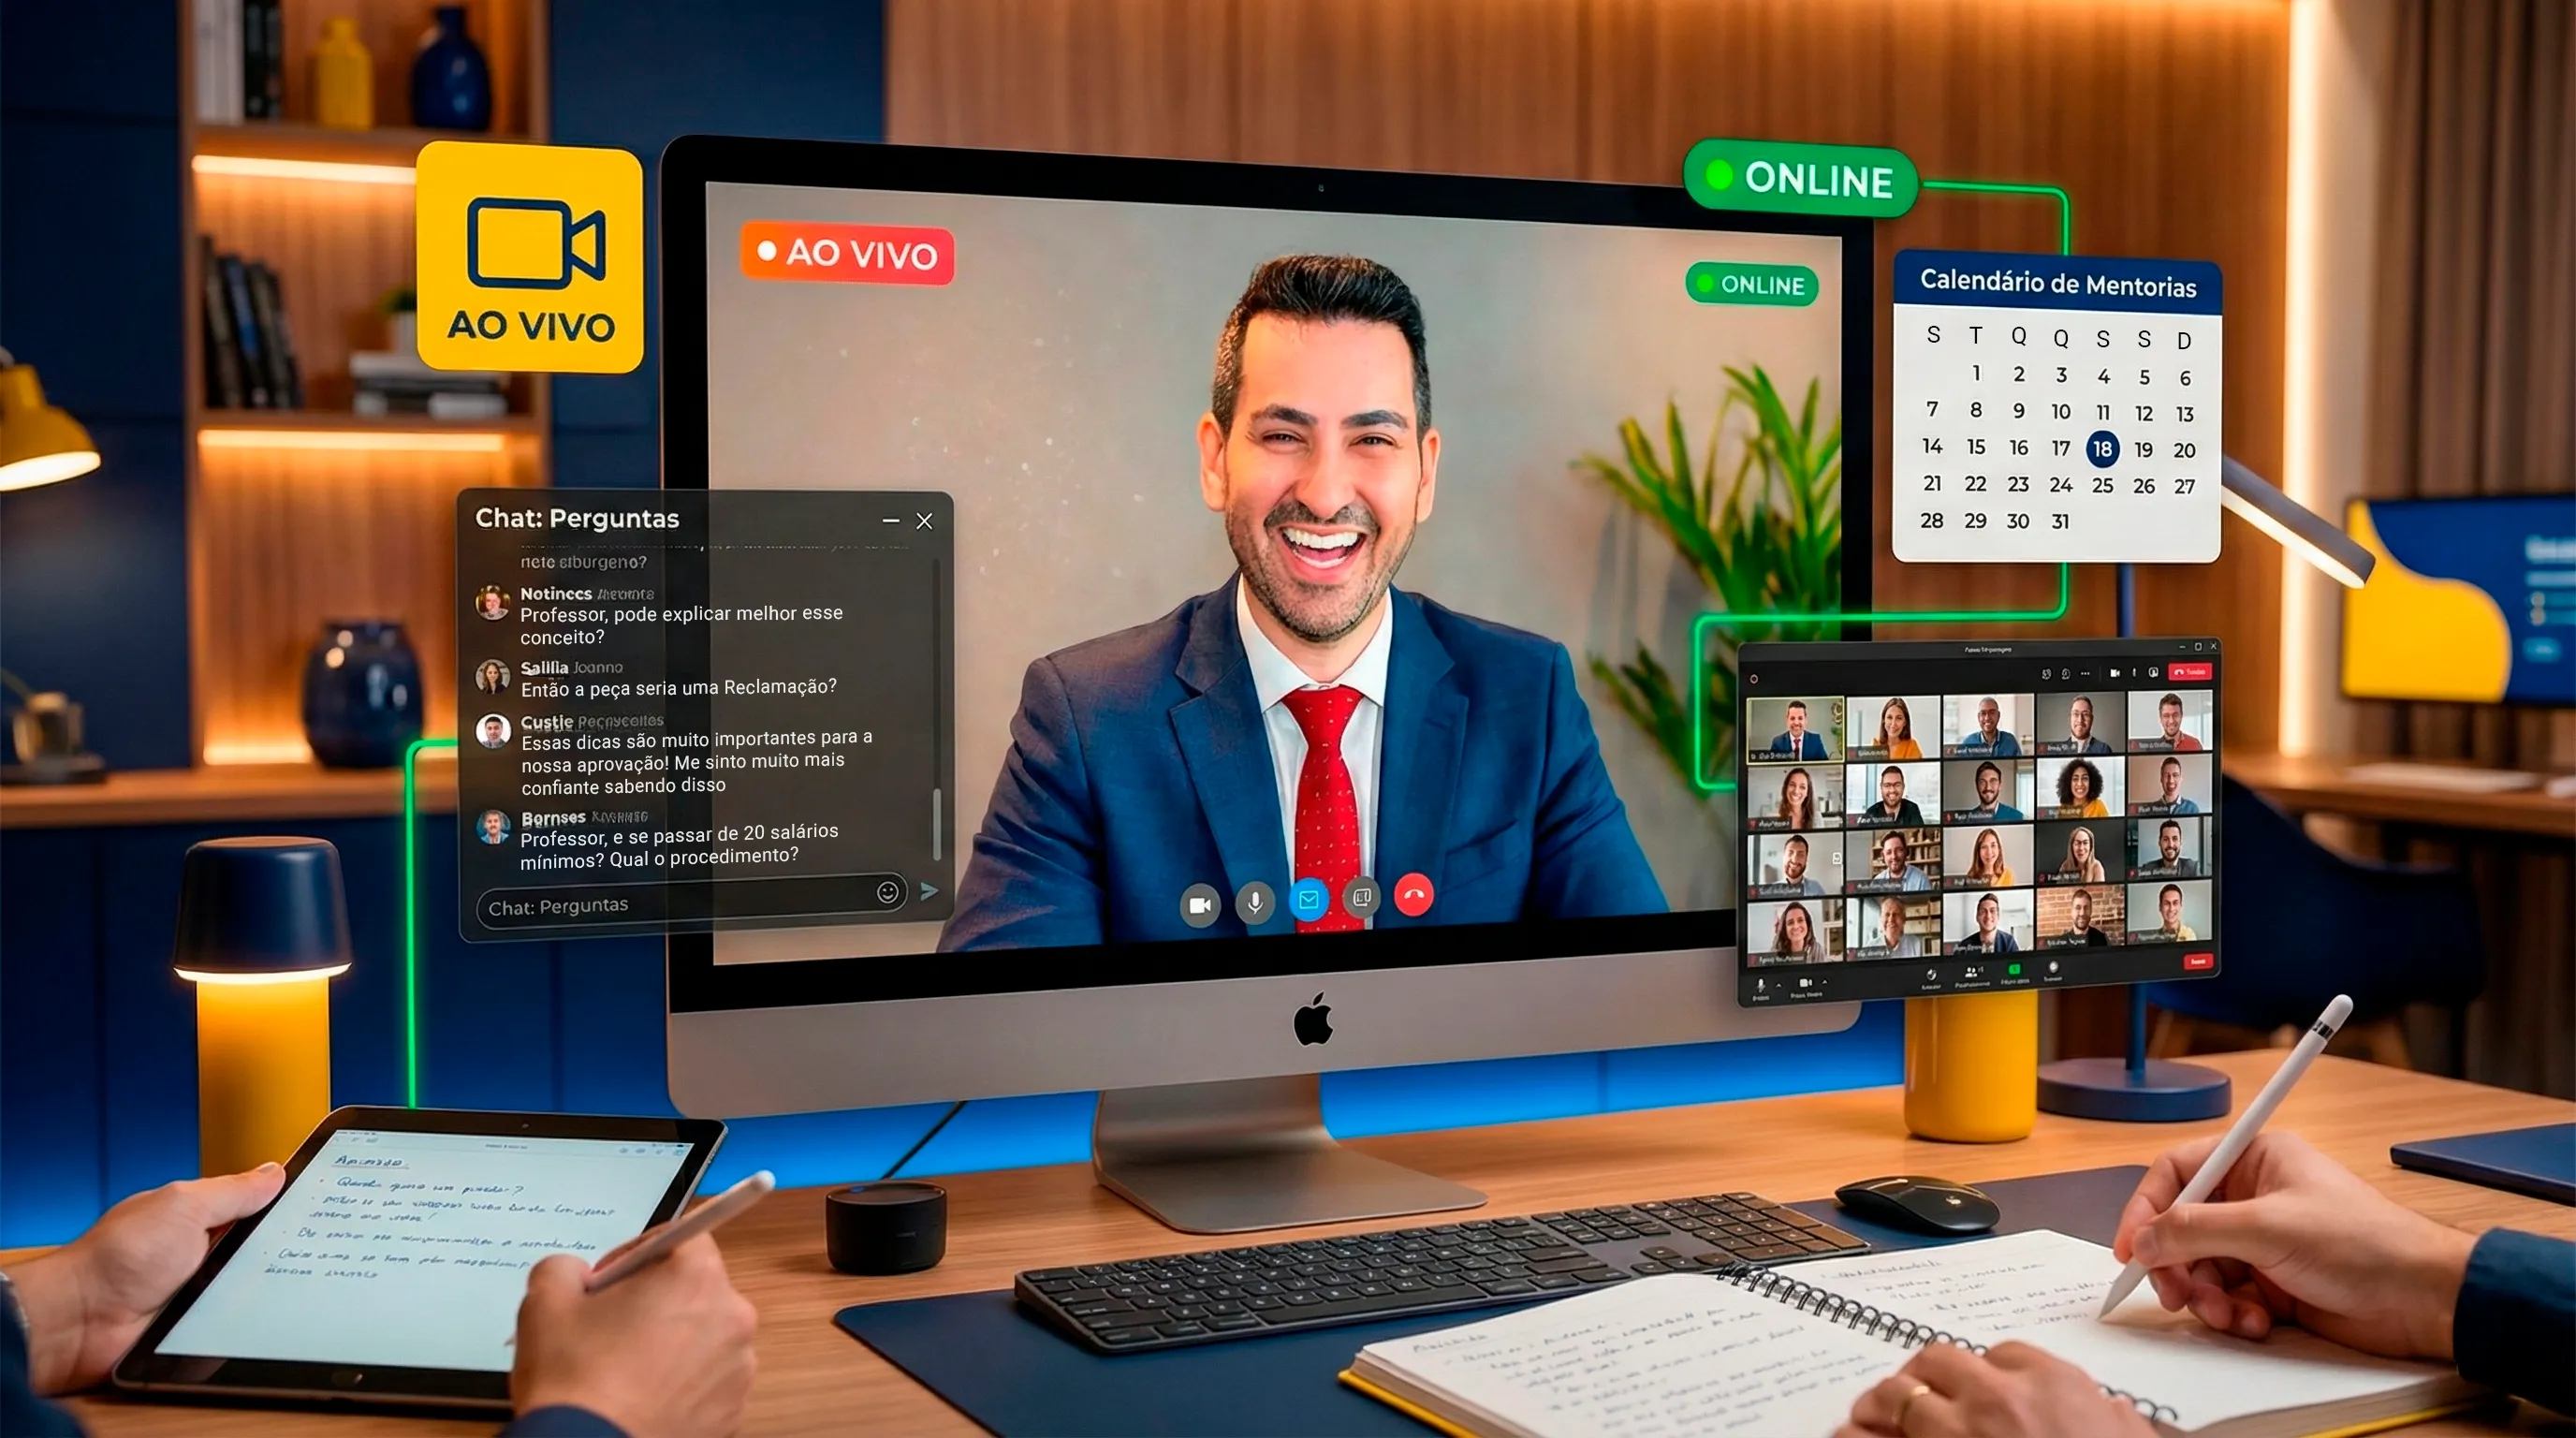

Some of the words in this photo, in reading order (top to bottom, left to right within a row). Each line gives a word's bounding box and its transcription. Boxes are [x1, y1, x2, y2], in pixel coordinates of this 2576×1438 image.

[786, 239, 840, 266] AO
[851, 241, 937, 271] VIVO
[1722, 275, 1805, 295] ONLINE
[476, 507, 542, 527] Chat:
[551, 509, 679, 533] Perguntas
[521, 607, 607, 624] Professor,
[615, 607, 656, 624] pode
[663, 606, 731, 624] explicar
[738, 606, 797, 621] melhor
[803, 609, 842, 620] esse
[521, 629, 604, 645] conceito?
[522, 682, 569, 697] Então
[576, 685, 584, 697] a
[591, 684, 630, 699] peça
[637, 681, 676, 696] seria
[683, 683, 718, 696] uma
[725, 678, 837, 697] Reclamação?
[523, 736, 570, 750] Essas
[577, 734, 621, 749] dicas
[627, 733, 656, 748] são
[663, 732, 709, 747] muito
[716, 732, 815, 749] importantes
[822, 732, 856, 747] para
[864, 732, 871, 742] a
[522, 761, 571, 773] nossa
[578, 756, 668, 775] aprovação!
[676, 756, 699, 770] Me
[706, 756, 746, 770] sinto
[753, 753, 798, 768] muito
[805, 753, 844, 766] mais
[522, 779, 599, 795] confiante
[605, 777, 676, 794] sabendo
[681, 776, 725, 791] disso
[521, 830, 607, 847] Professor,
[614, 833, 622, 844] e
[629, 832, 648, 844] se
[654, 830, 712, 846] passar
[718, 826, 738, 841] de
[744, 825, 764, 840] 20
[771, 824, 838, 839] salários
[521, 853, 604, 870] mínimos?
[610, 851, 648, 868] Qual
[655, 855, 665, 865] o
[671, 846, 798, 868] procedimento?
[490, 901, 534, 916] Chat:
[541, 900, 628, 917] Perguntas
